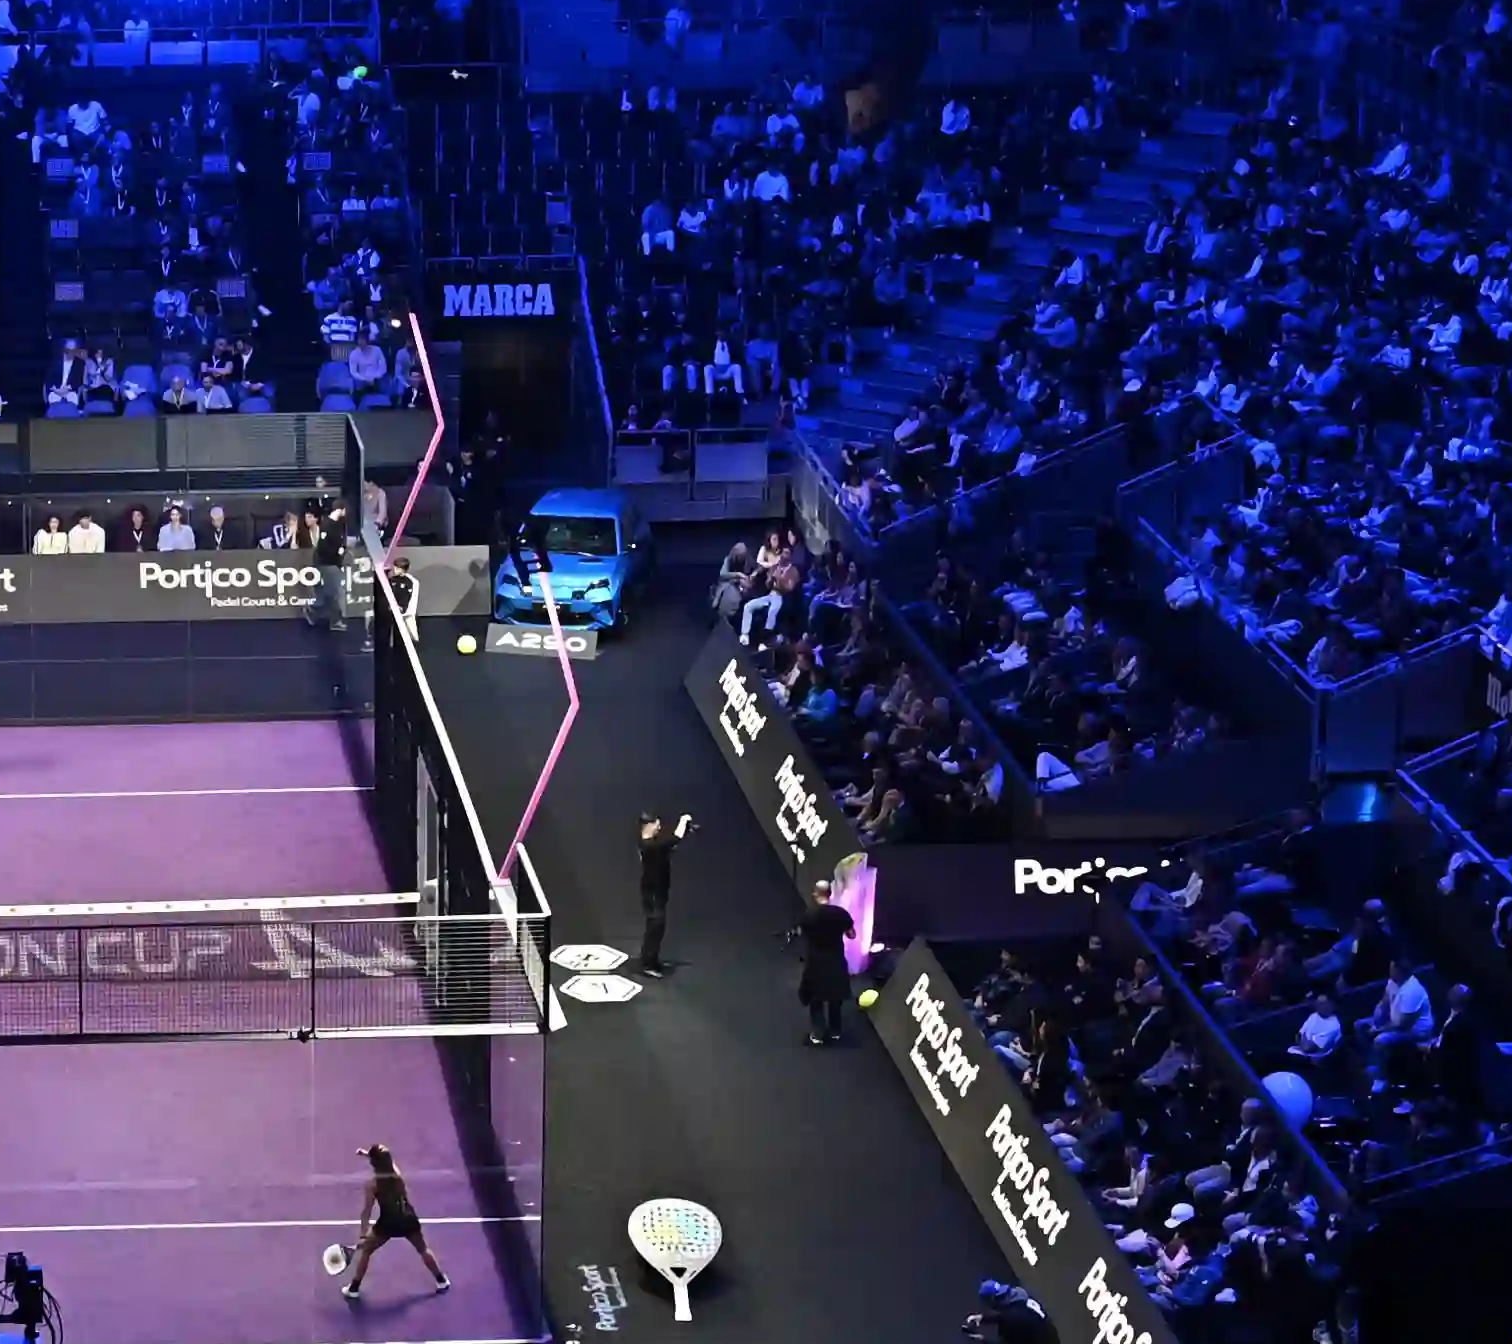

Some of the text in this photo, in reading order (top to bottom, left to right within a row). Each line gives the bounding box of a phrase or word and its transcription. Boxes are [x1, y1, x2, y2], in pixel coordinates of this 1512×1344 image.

[443, 283, 555, 317] MARCA
[139, 560, 252, 597] Portico
[257, 560, 324, 594] Spo
[210, 596, 241, 608] Padel
[241, 596, 276, 607] Courts
[495, 631, 587, 653] A290
[737, 693, 767, 741] Sport
[796, 794, 828, 847] Sport
[86, 928, 232, 977] CUP
[906, 972, 949, 1049] Portico
[937, 1027, 980, 1097] Sport
[986, 1104, 1034, 1190] Portico
[1023, 1167, 1070, 1246] Sport
